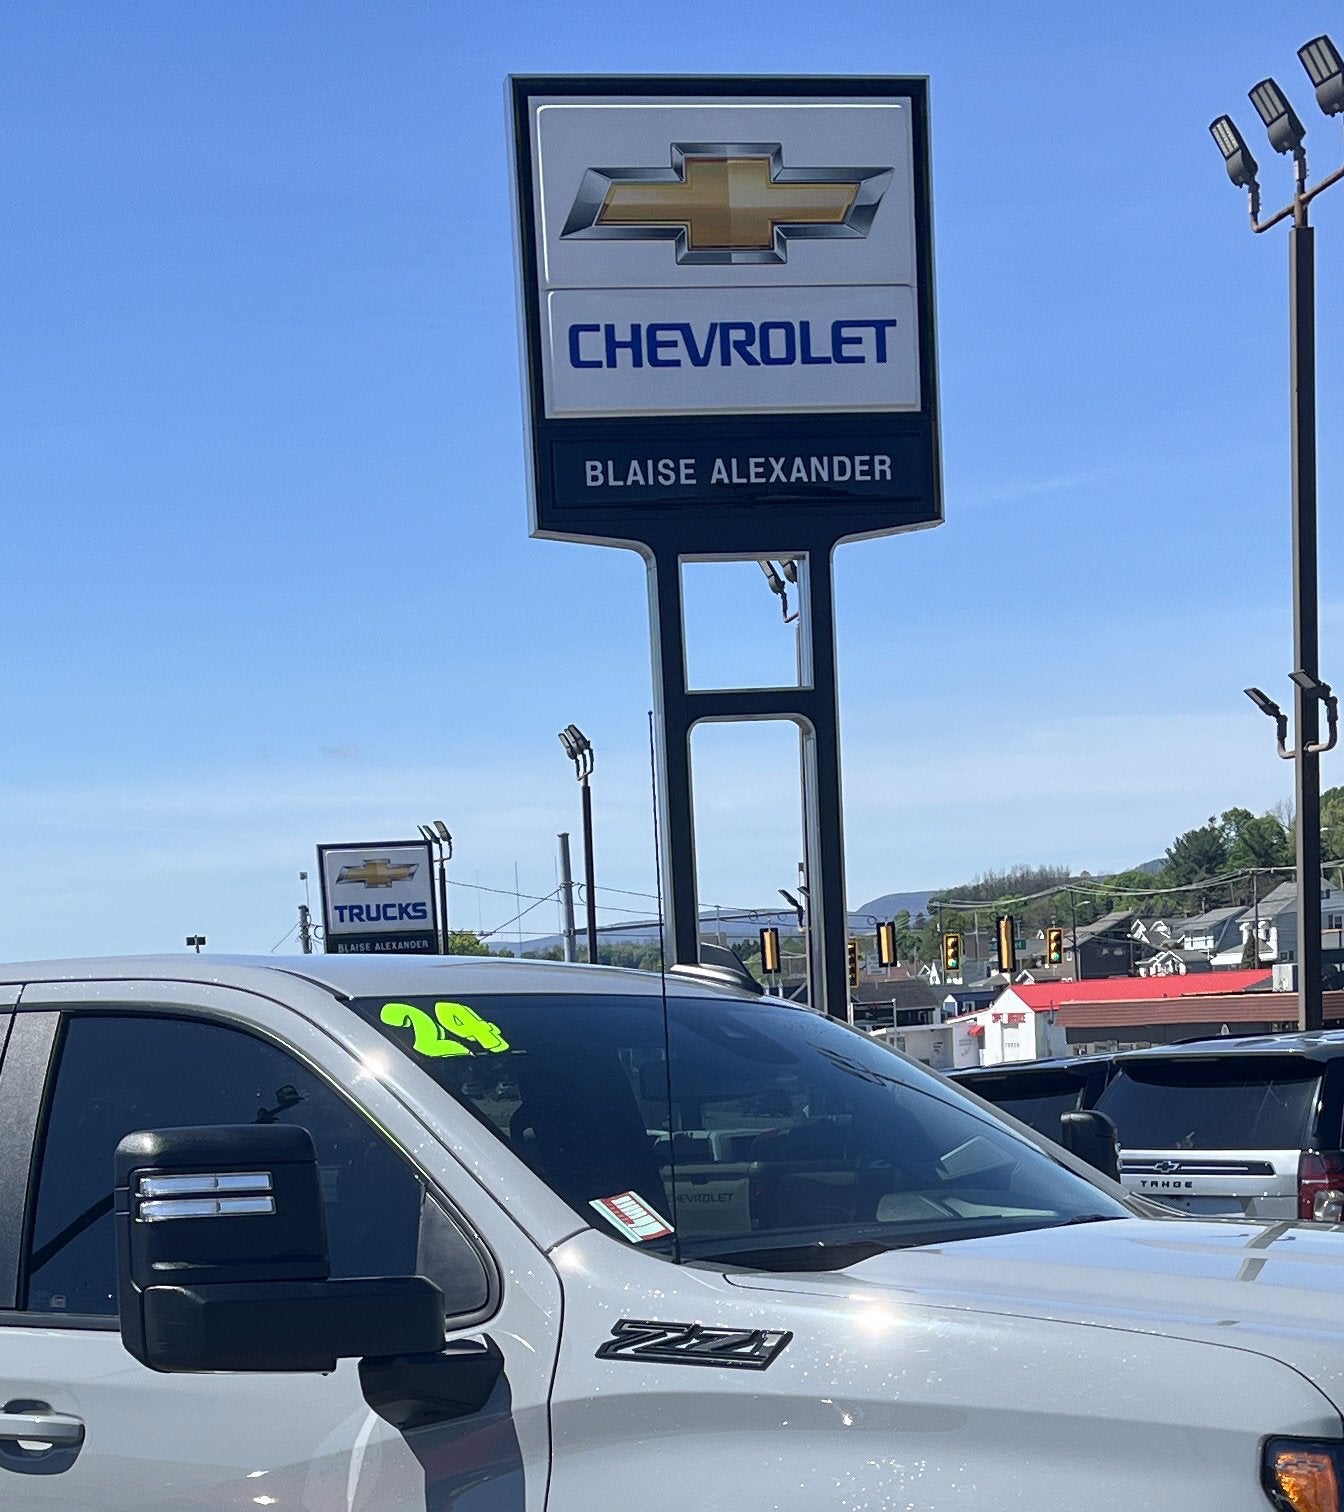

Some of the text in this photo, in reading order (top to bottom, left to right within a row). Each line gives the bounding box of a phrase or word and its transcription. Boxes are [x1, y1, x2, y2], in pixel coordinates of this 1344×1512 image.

[568, 318, 897, 369] CHEVROLET
[585, 455, 893, 487] BLAISE ALEXANDER
[334, 901, 428, 923] TRUCKS
[337, 939, 429, 954] BLAISE ALEXANDER
[380, 1001, 510, 1058] 24
[1140, 1180, 1193, 1189] TAHOE
[594, 1318, 795, 1372] Z71
